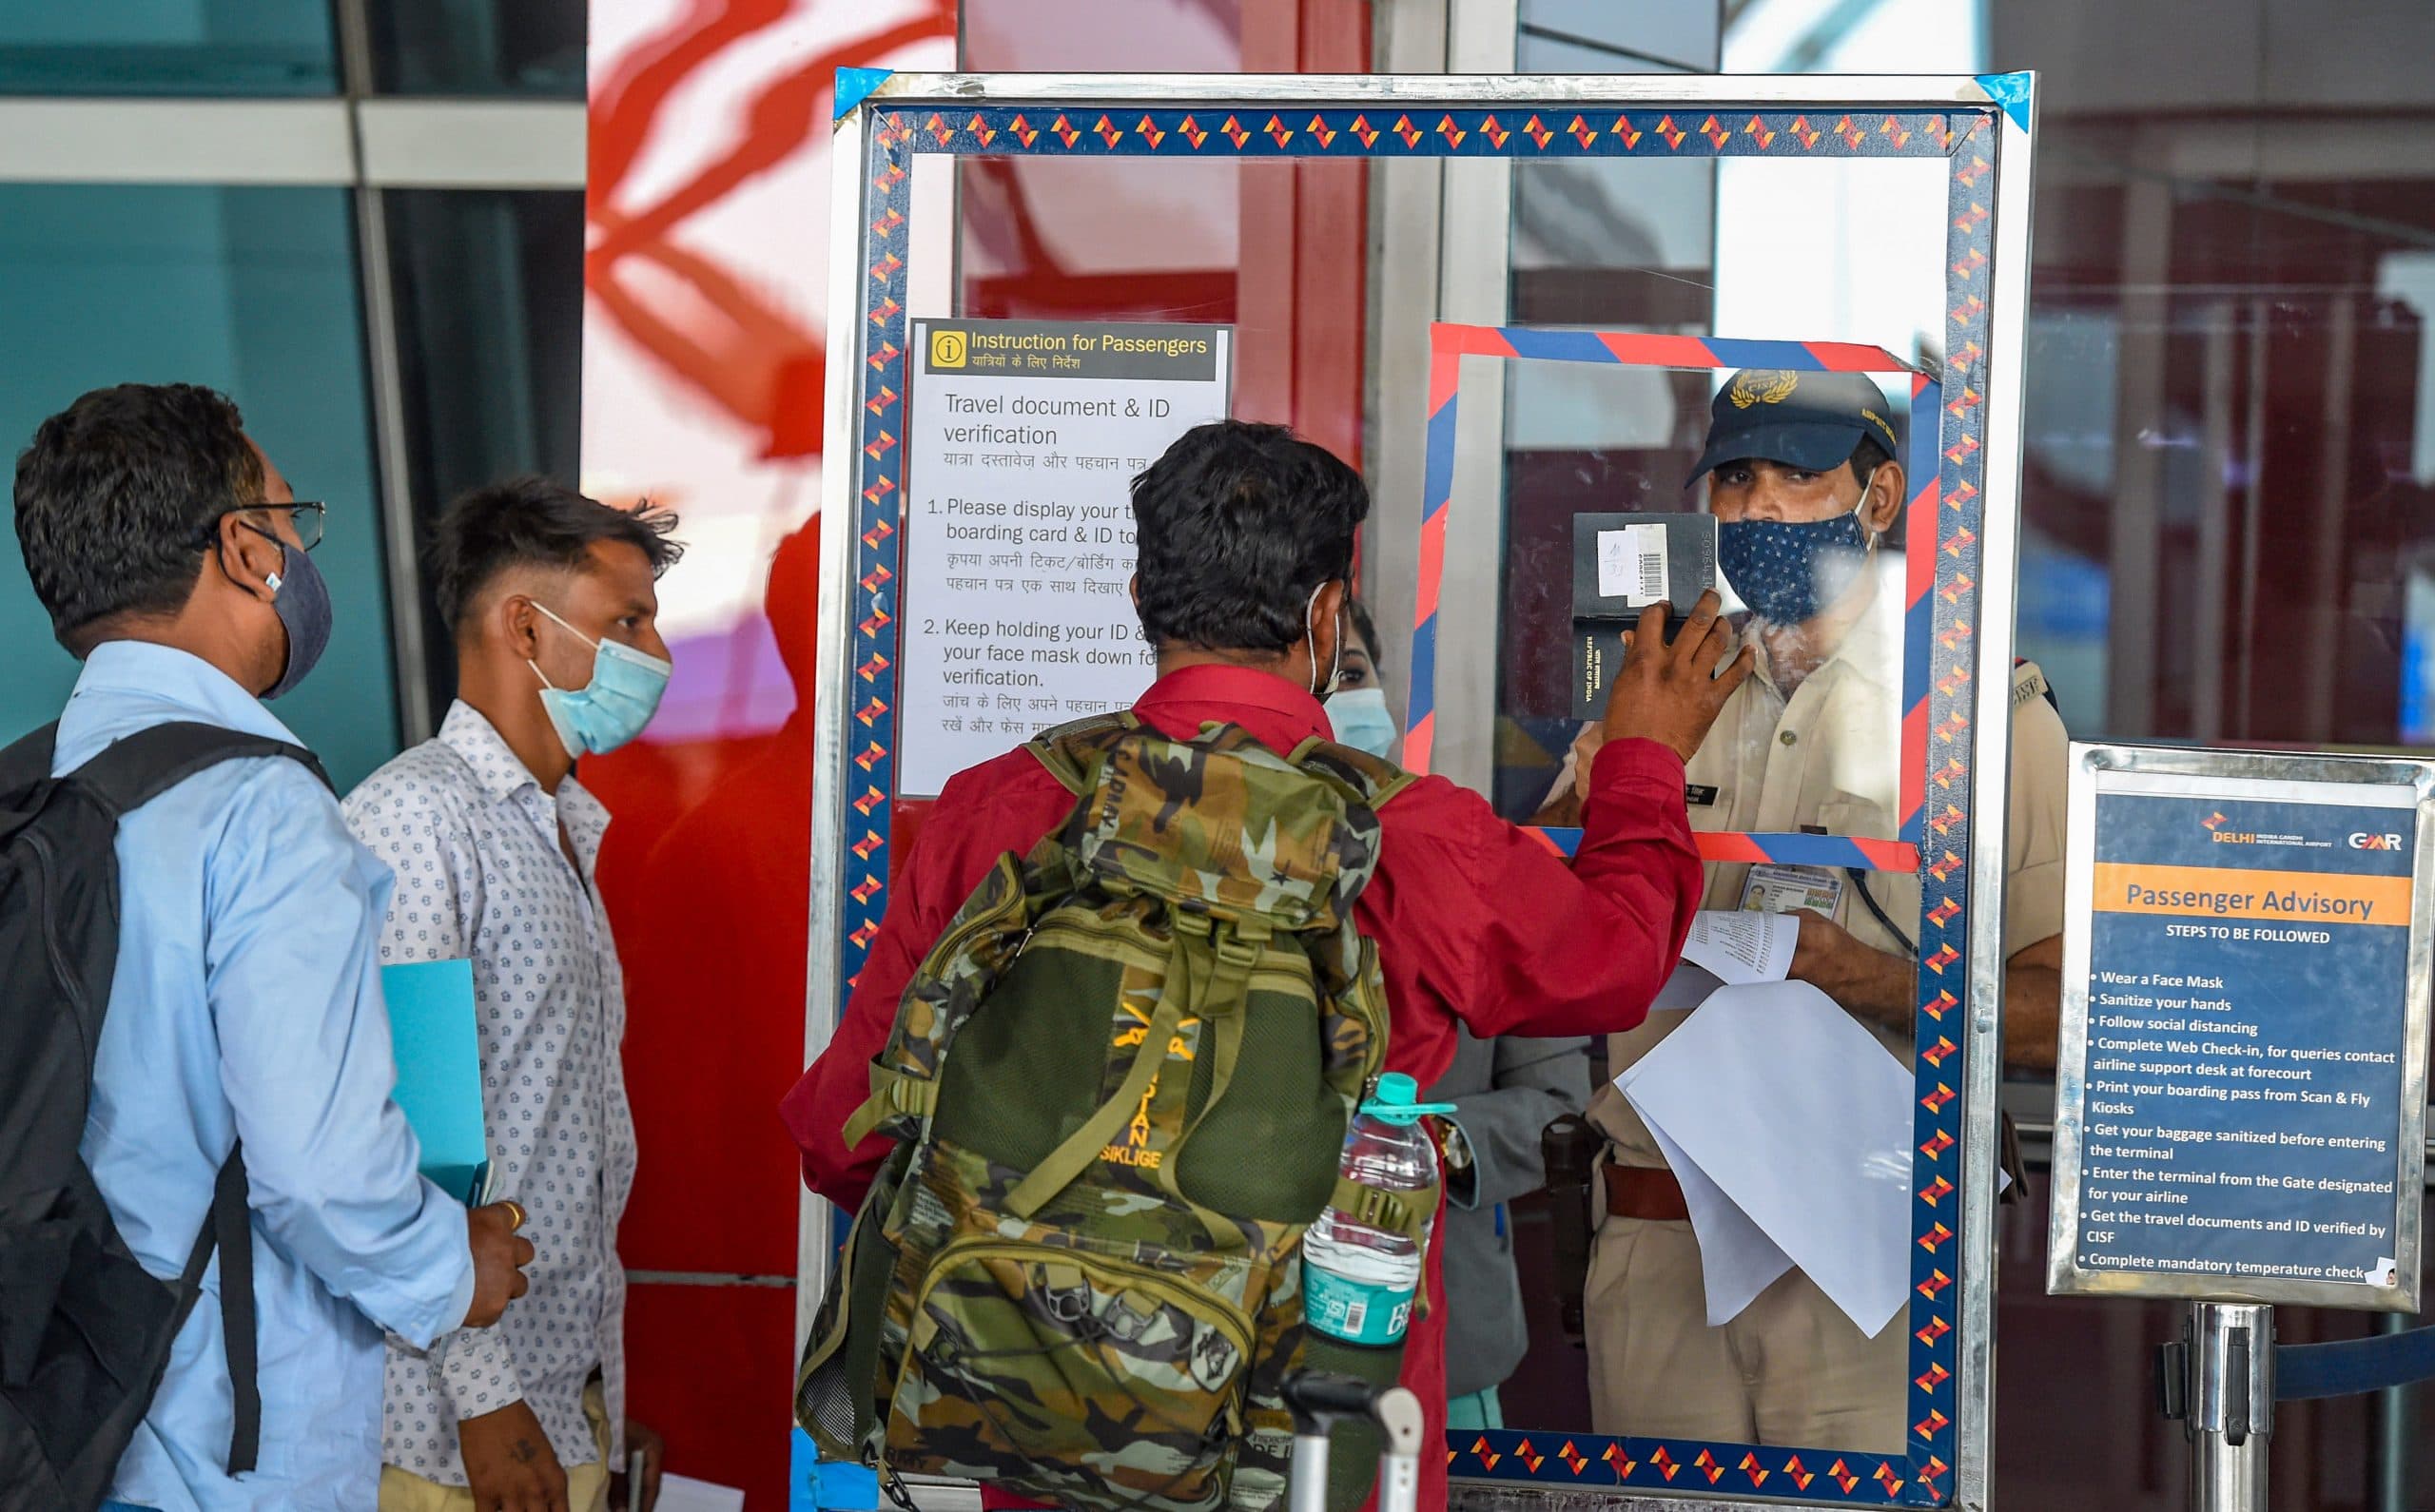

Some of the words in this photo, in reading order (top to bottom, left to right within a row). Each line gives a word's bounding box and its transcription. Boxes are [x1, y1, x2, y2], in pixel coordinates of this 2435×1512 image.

[972, 331, 1065, 350] Instruction
[1073, 335, 1098, 350] for
[1103, 335, 1206, 358] Passengers
[945, 394, 1003, 413] Travel
[1012, 396, 1117, 417] document
[1124, 397, 1140, 417] &
[1149, 399, 1170, 418] ID
[944, 424, 1056, 445] verification
[928, 498, 944, 514] 1.
[947, 498, 1006, 515] Please
[1014, 500, 1075, 521] display
[1081, 506, 1119, 521] your
[947, 523, 1023, 546] boarding
[1029, 527, 1067, 542] card
[1073, 527, 1086, 542] &
[1096, 527, 1113, 544] ID
[945, 577, 987, 591] पहचान
[995, 579, 1013, 591] पत्र
[1022, 580, 1042, 593] एक
[1050, 580, 1076, 593] साथ
[925, 618, 940, 635] 2.
[945, 618, 989, 639] Keep
[997, 620, 1060, 643] holding
[1065, 626, 1103, 643] your
[1111, 624, 1128, 641] ID
[944, 647, 982, 662] your
[987, 645, 1023, 662] face
[1031, 647, 1079, 664] mask
[1086, 649, 1132, 666] down
[944, 668, 1042, 687] verification.
[944, 692, 968, 708] जांच
[976, 692, 989, 708] के
[997, 693, 1022, 711] लिए
[1028, 695, 1057, 710] अपने
[1065, 700, 1106, 712] पहचान
[2212, 831, 2254, 843] DELHI
[2127, 884, 2254, 913] Passenger
[2262, 890, 2372, 921] Advisory
[2167, 924, 2207, 938] STEPS
[2211, 926, 2230, 940] TO
[2233, 928, 2250, 940] BE
[2254, 928, 2330, 943] FOLLOWED
[2100, 972, 2138, 983] Wear
[2140, 976, 2148, 985] a
[2153, 974, 2184, 987] Face
[2186, 976, 2224, 989] Mask
[2100, 993, 2153, 1008] Sanitize
[2155, 998, 2188, 1010] your
[2192, 997, 2231, 1012] hands
[2100, 1016, 2144, 1029] Follow
[2148, 1018, 2186, 1031] social
[2190, 1019, 2258, 1037] distancing
[2098, 1037, 2163, 1054] Complete
[2167, 1040, 2199, 1054] Web
[2201, 1042, 2264, 1059] Check-in,
[2268, 1044, 2289, 1057] for
[2290, 1048, 2342, 1061] queries
[2344, 1052, 2395, 1063] contact
[2093, 1057, 2136, 1071] airline
[2140, 1063, 2192, 1076] support
[2195, 1063, 2228, 1076] desk
[2231, 1067, 2245, 1076] at
[2249, 1065, 2311, 1080] forecourt
[2096, 1080, 2129, 1094] Print
[2133, 1084, 2165, 1095] your
[2167, 1084, 2228, 1101] boarding
[2231, 1090, 2260, 1101] pass
[2264, 1088, 2296, 1101] from
[2300, 1090, 2332, 1103] Scan
[2336, 1092, 2347, 1103] &
[2351, 1094, 2370, 1109] Fly
[2093, 1101, 2134, 1115] Kiosks
[2094, 1124, 2119, 1135] Get
[2121, 1128, 2153, 1139] your
[2157, 1126, 2212, 1143] baggage
[2216, 1130, 2277, 1143] sanitized
[2279, 1132, 2325, 1147] before
[2328, 1137, 2386, 1153] entering
[1101, 1145, 1162, 1168] SIKLIGE
[2089, 1143, 2112, 1156] the
[2115, 1147, 2172, 1160] terminal
[2093, 1166, 2129, 1179] Enter
[2133, 1168, 2155, 1181] the
[2159, 1172, 2216, 1183] terminal
[2220, 1172, 2252, 1185] from
[2256, 1175, 2279, 1187] the
[2283, 1175, 2315, 1189] Gate
[2319, 1177, 2393, 1194] designated
[2089, 1187, 2108, 1200] for
[2112, 1191, 2142, 1202] your
[2146, 1191, 2188, 1204] airline
[2091, 1210, 2115, 1223] Get
[2119, 1212, 2140, 1223] the
[2144, 1213, 2184, 1225] travel
[2188, 1213, 2262, 1231] documents
[2266, 1219, 2290, 1231] and
[2296, 1221, 2309, 1232] ID
[2313, 1221, 2365, 1234] verified
[2368, 1223, 2386, 1238] by
[2087, 1231, 2115, 1242] CISF
[2089, 1253, 2153, 1269] Complete
[2157, 1257, 2231, 1274] mandatory
[2235, 1261, 2321, 1278] temperature
[2325, 1265, 2363, 1278] check
